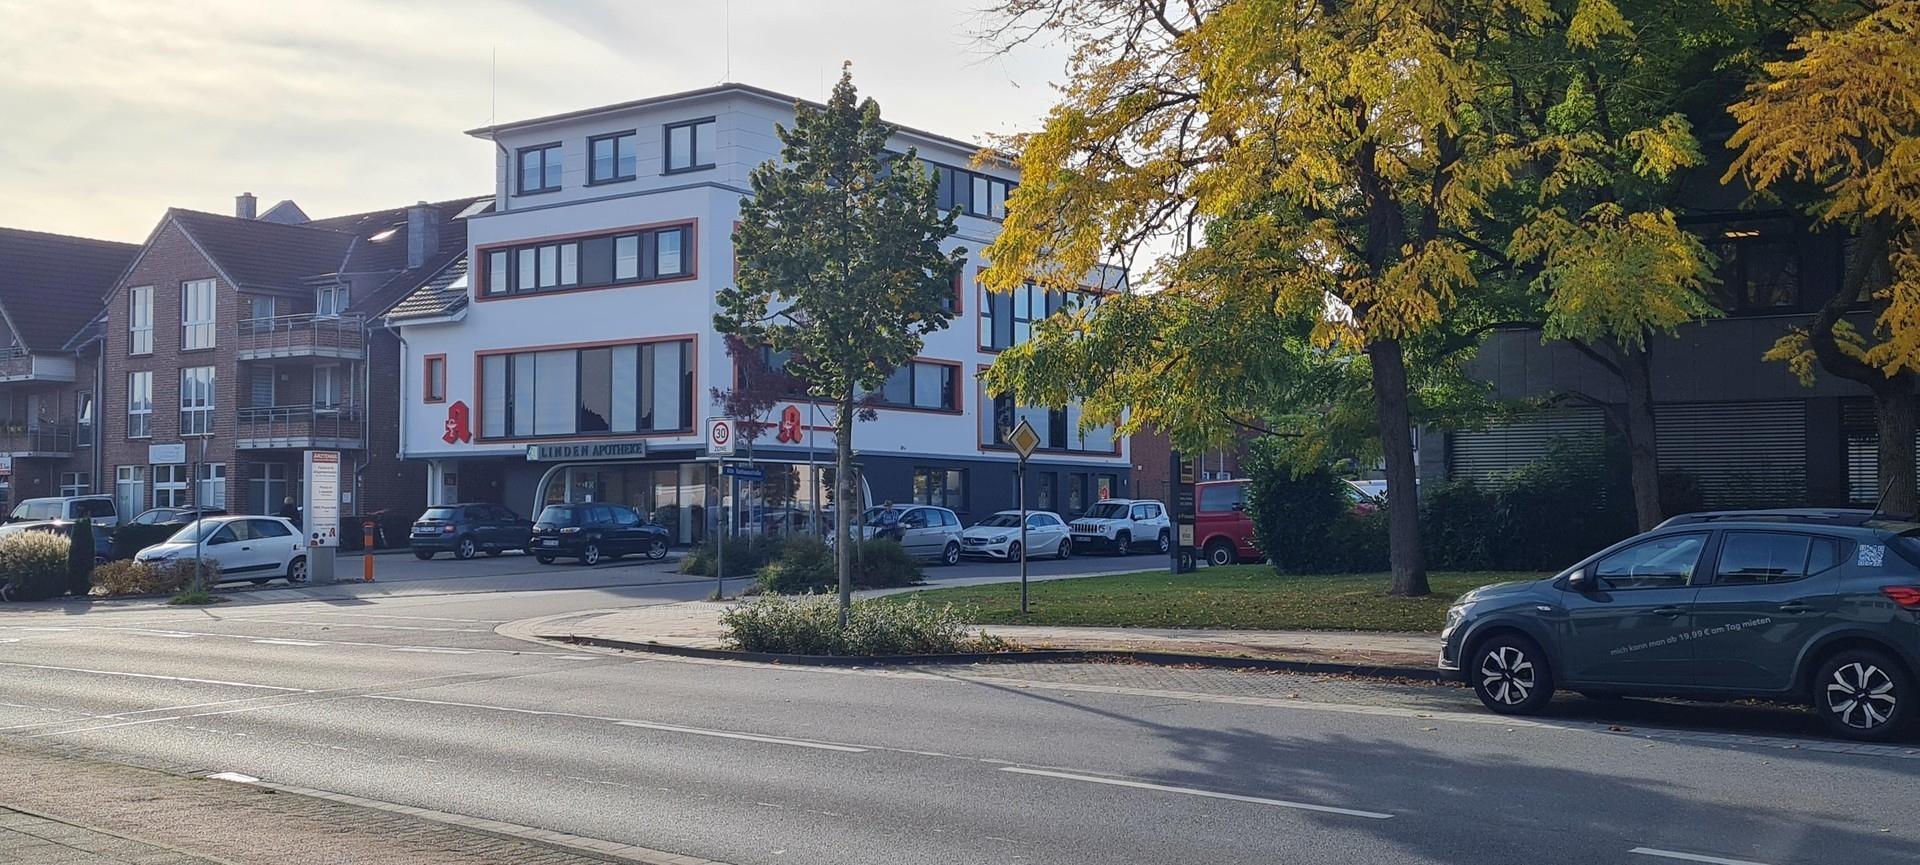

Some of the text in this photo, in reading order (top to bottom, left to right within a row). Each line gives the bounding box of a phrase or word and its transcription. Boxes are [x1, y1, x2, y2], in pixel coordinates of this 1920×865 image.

[715, 428, 726, 439] 30
[541, 443, 643, 458] LINDEN APOTHEKE
[1610, 646, 1629, 656] mich
[1629, 642, 1648, 651] kann
[1649, 639, 1666, 647] man
[1666, 635, 1678, 644] ab
[1679, 629, 1703, 641] 19,99
[1725, 623, 1742, 632] Tag
[1742, 617, 1771, 628] mieten
